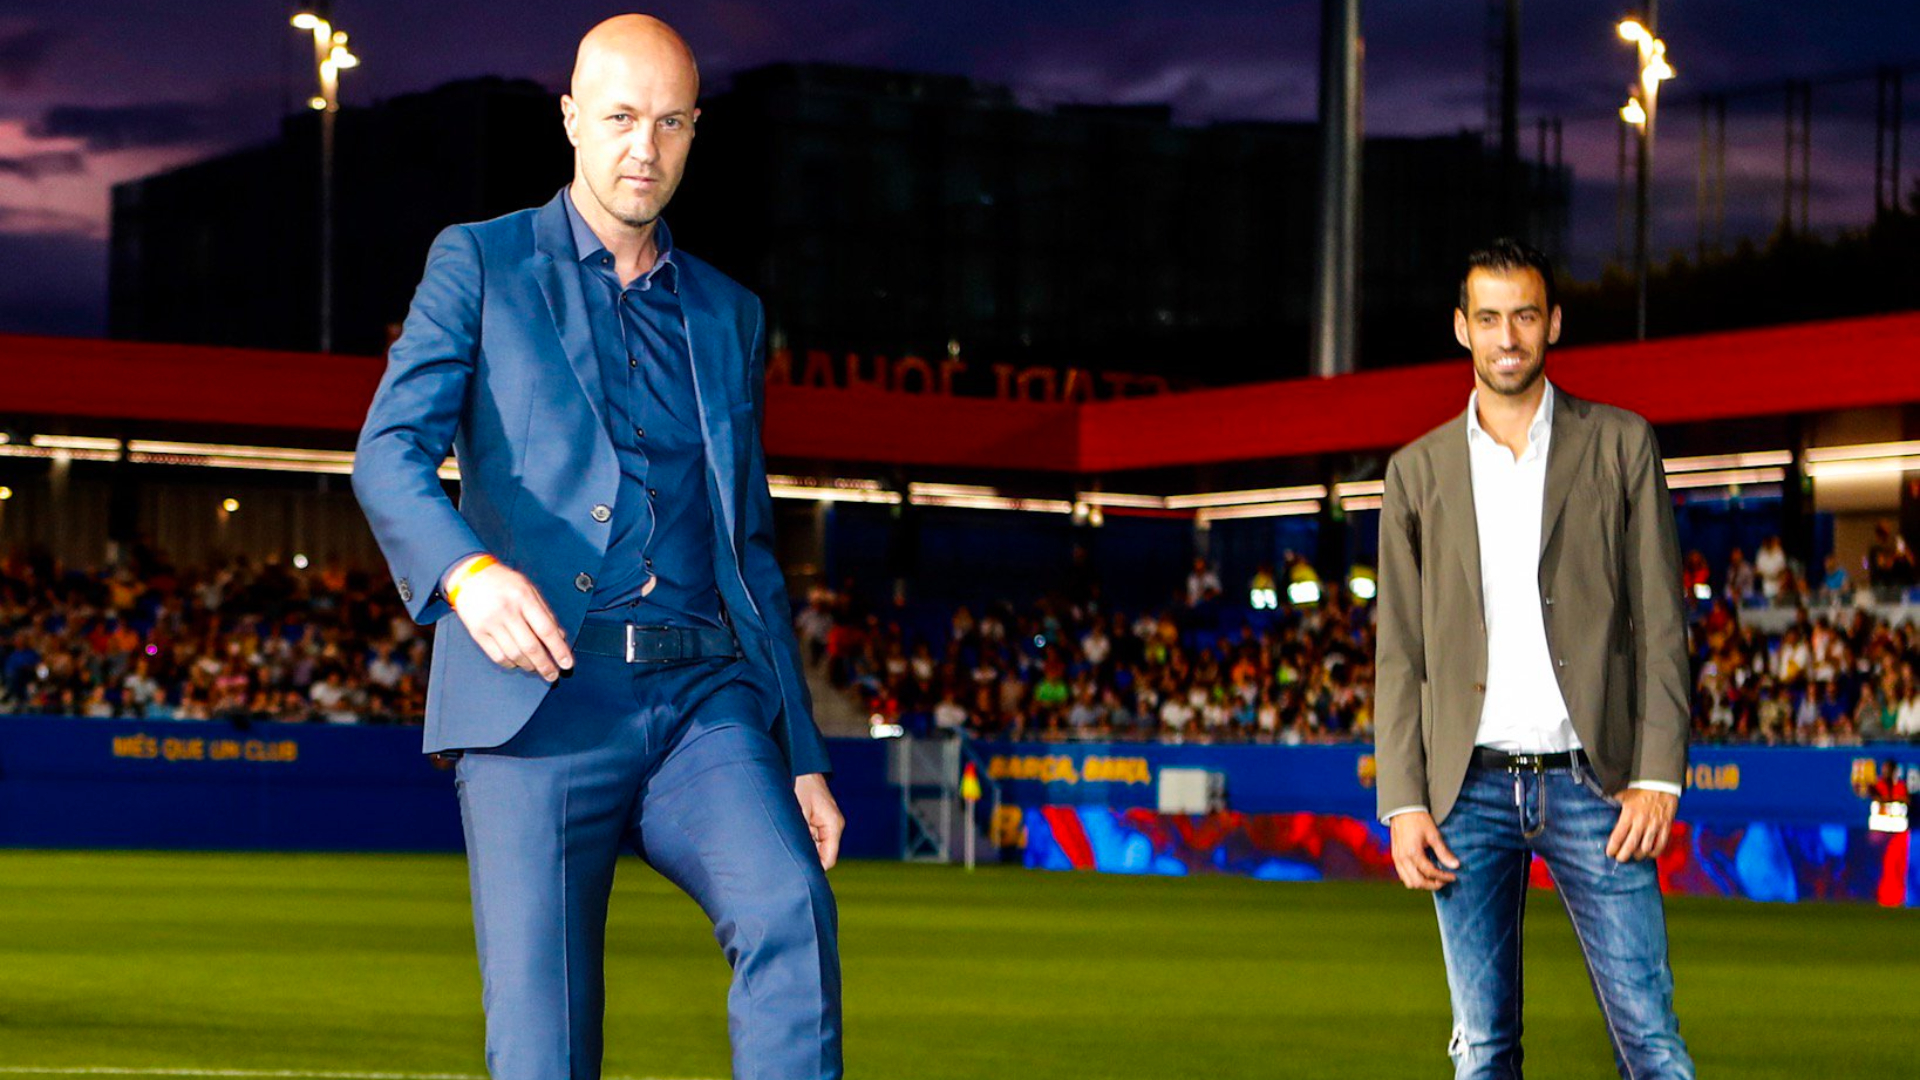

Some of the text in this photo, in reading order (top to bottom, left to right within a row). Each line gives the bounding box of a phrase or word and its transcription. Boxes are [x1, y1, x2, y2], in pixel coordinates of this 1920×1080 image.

[162, 737, 205, 760] QUE
[208, 739, 241, 760] UN
[244, 739, 298, 761] CLUB
[1695, 763, 1740, 790] CLUB
